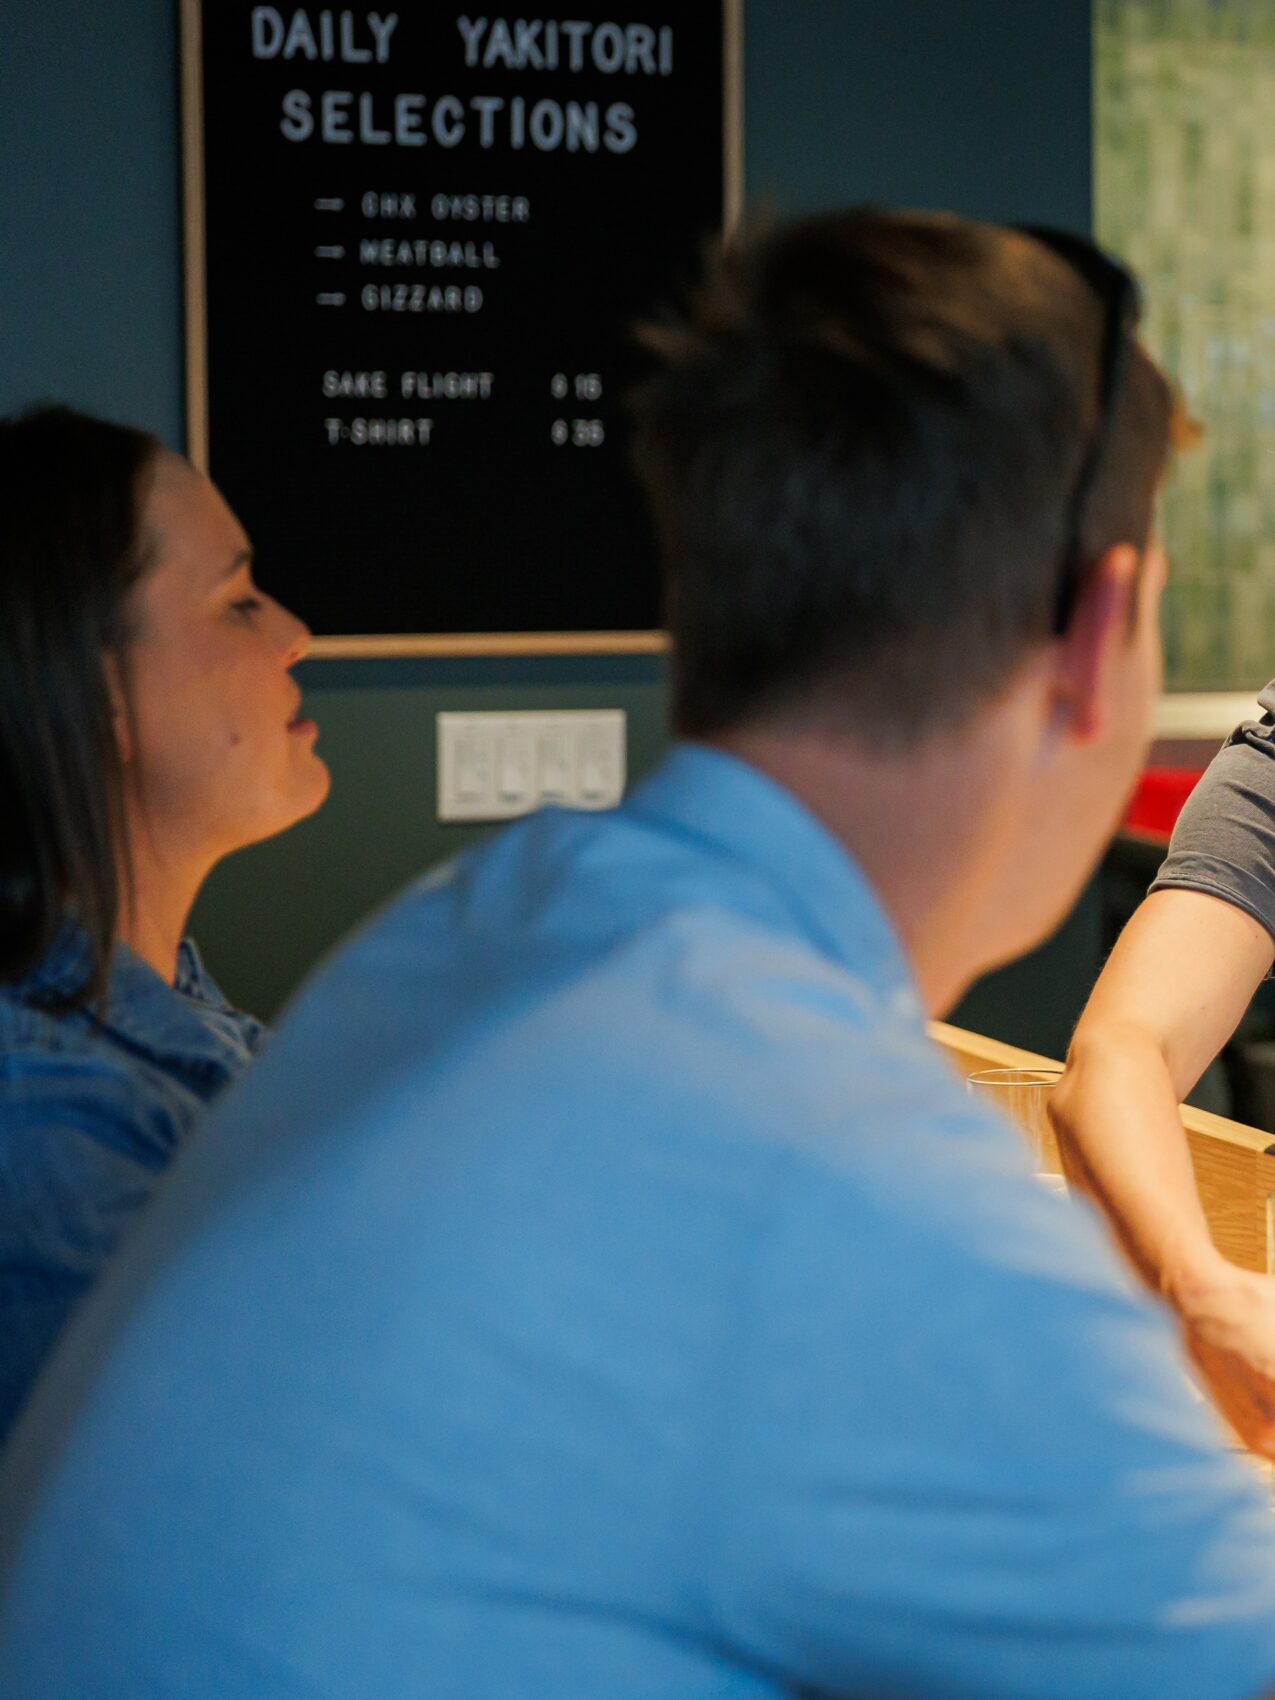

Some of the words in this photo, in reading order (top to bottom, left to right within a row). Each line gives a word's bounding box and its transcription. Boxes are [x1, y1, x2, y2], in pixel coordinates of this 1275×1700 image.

[252, 6, 397, 62] DAILY
[458, 16, 672, 75] YAKITORI
[281, 90, 637, 153] SELECTIONS
[432, 194, 529, 221] OYSTER
[360, 239, 498, 267] MEATBALL
[362, 285, 483, 312] GIZZARD
[323, 371, 387, 399] SAKE
[402, 372, 492, 399] FLIGHT
[326, 418, 432, 444] T-SHIRT
